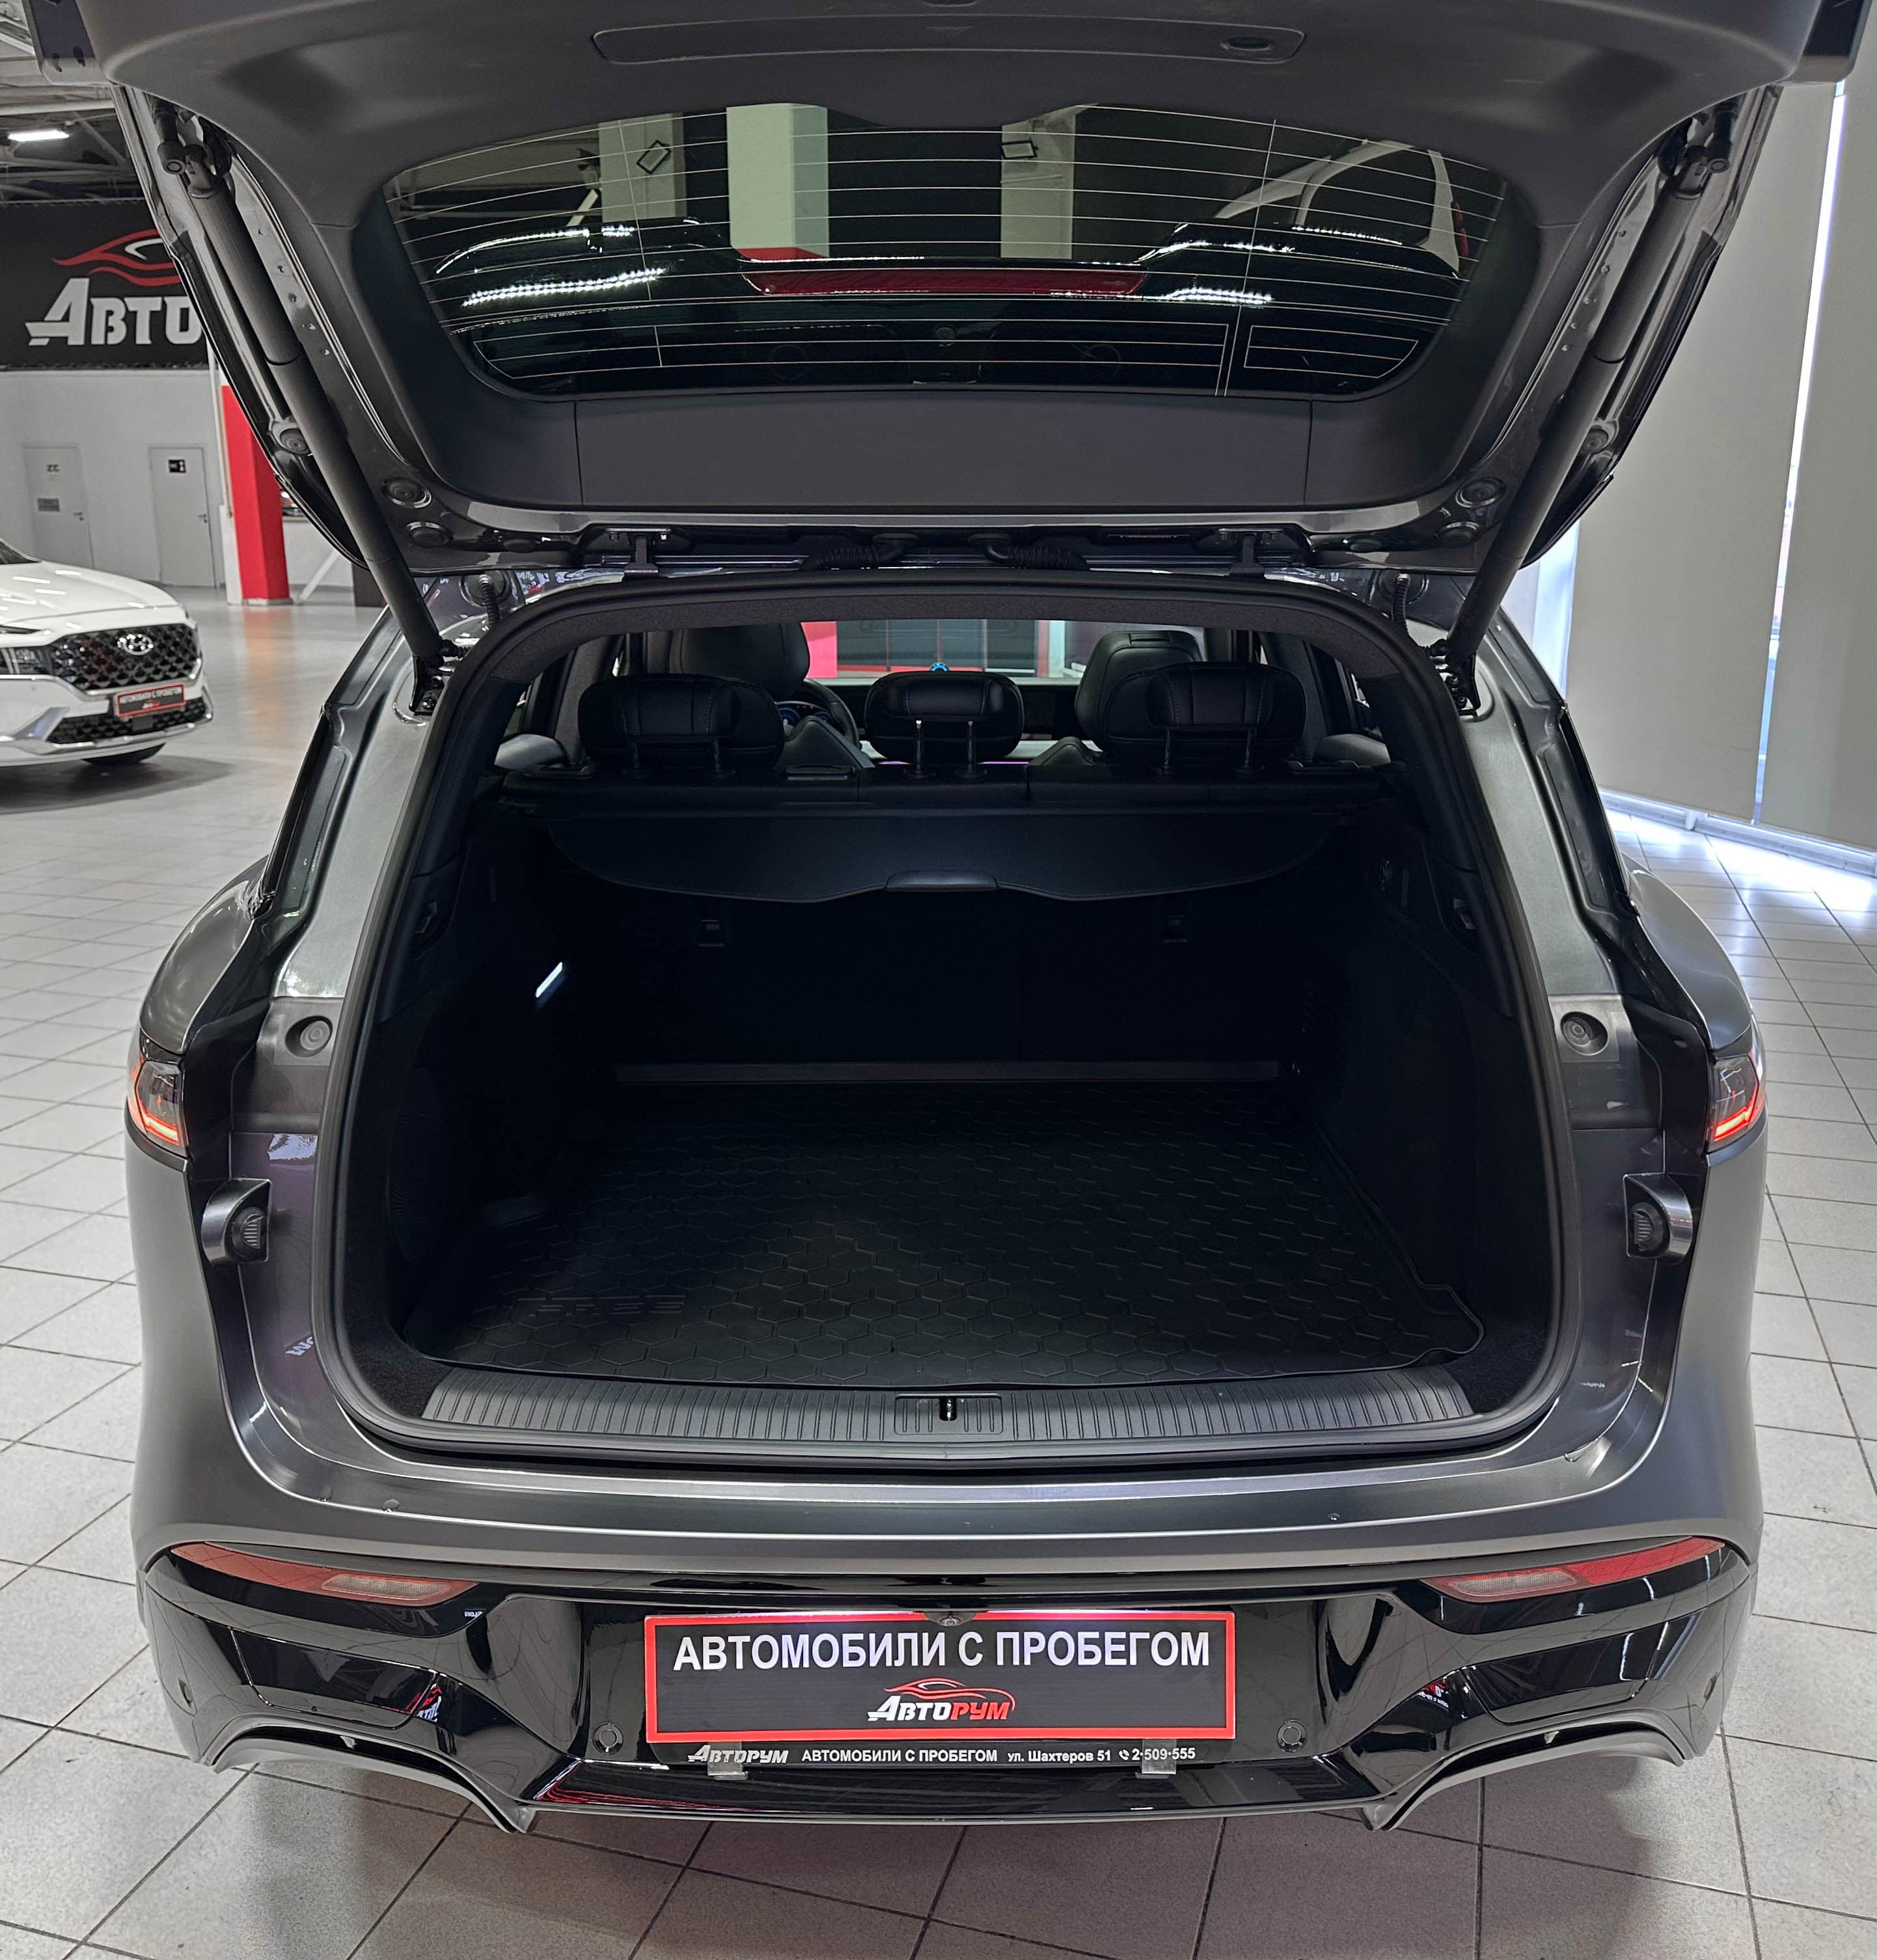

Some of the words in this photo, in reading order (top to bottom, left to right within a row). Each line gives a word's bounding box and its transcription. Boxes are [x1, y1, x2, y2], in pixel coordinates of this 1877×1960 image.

[673, 1632, 946, 1671] АВТОМОБИЛИ
[958, 1631, 983, 1666] С
[996, 1631, 1209, 1666] ПРОБЕГОМ
[802, 1749, 901, 1762] АВТОМОБИЛИ
[905, 1749, 916, 1762] С
[920, 1749, 997, 1762] ПРОБЕГОМ
[1007, 1752, 1024, 1763] ул.
[1028, 1750, 1093, 1765] Шахтеров
[1097, 1750, 1112, 1761] 51
